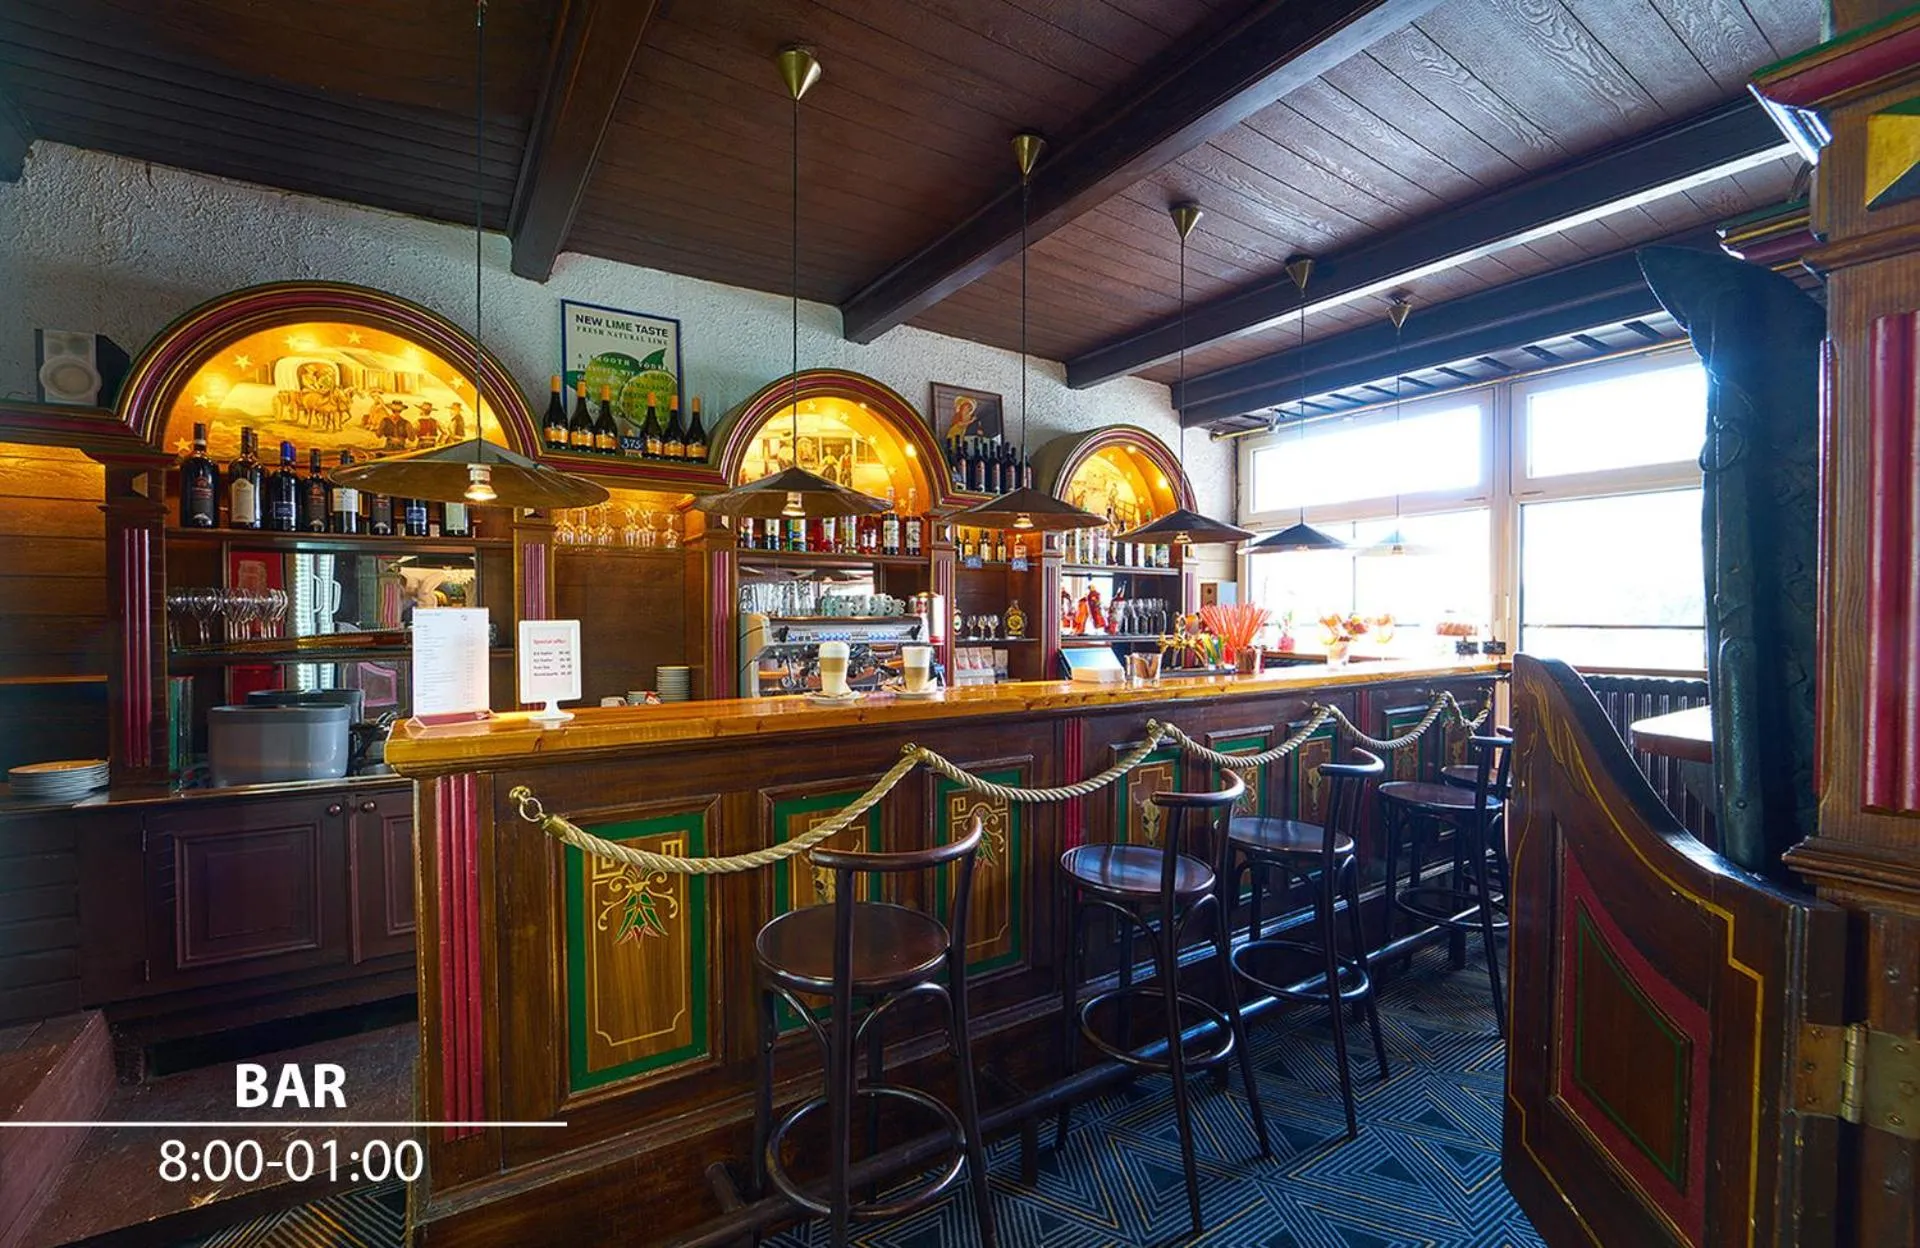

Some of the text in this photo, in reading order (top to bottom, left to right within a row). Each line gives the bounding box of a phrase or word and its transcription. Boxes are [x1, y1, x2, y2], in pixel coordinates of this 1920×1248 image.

[575, 314, 668, 337] NEW LIME TASTE
[576, 326, 604, 336] FRESH
[607, 331, 644, 342] NATURAL
